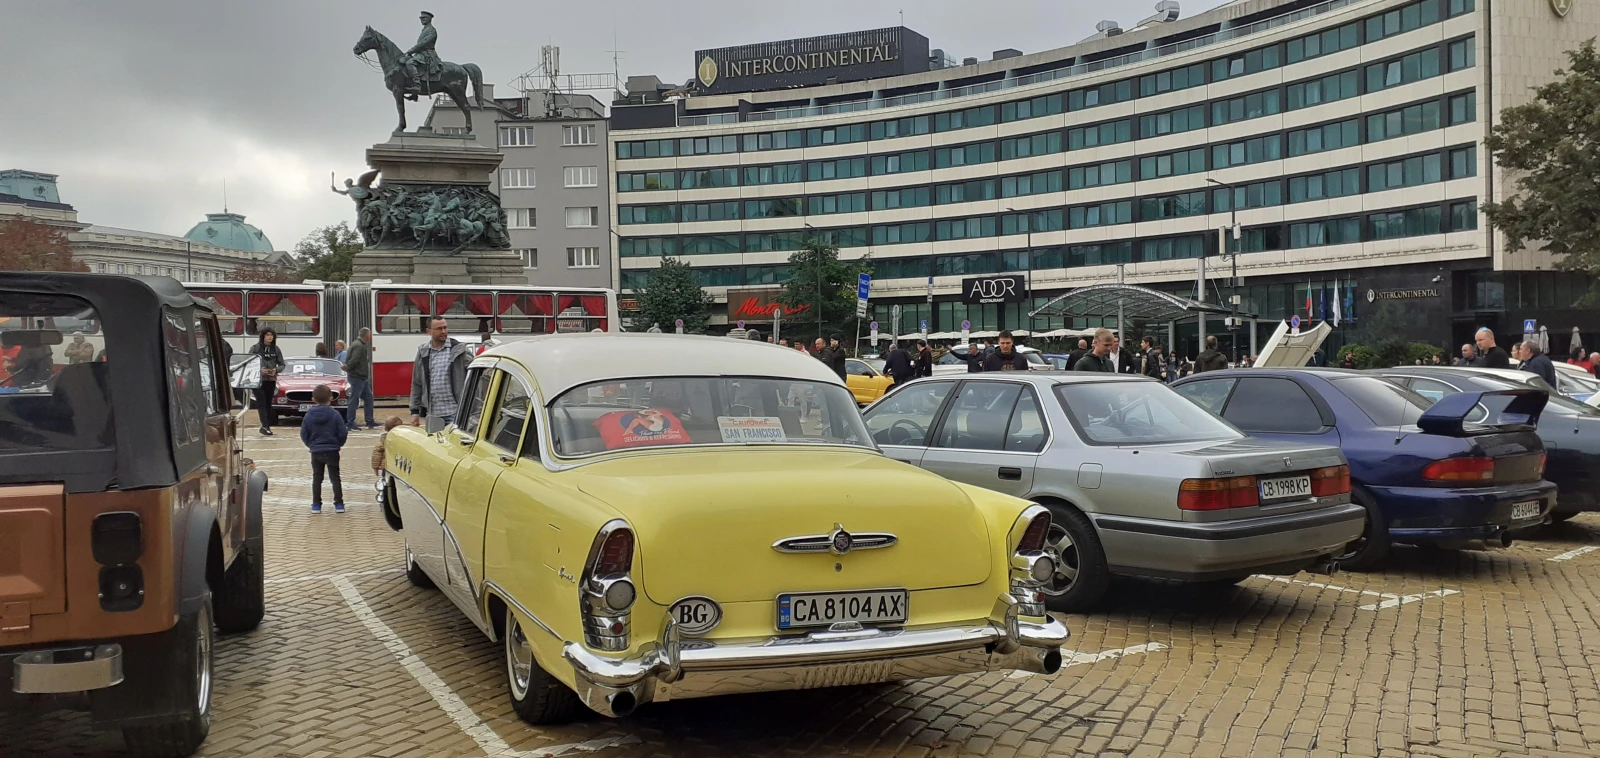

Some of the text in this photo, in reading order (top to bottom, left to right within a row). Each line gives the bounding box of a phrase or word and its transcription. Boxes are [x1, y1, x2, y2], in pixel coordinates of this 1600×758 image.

[725, 44, 894, 78] INTERCONTINENTAL
[970, 278, 1015, 298] ADOR
[1376, 289, 1438, 299] INTERCONTINENTAL
[724, 428, 782, 439] SAN FRANCISCO
[1262, 478, 1309, 496] CB 1998 KP
[679, 603, 708, 624] BG
[793, 595, 902, 622] CA 8104 AX
